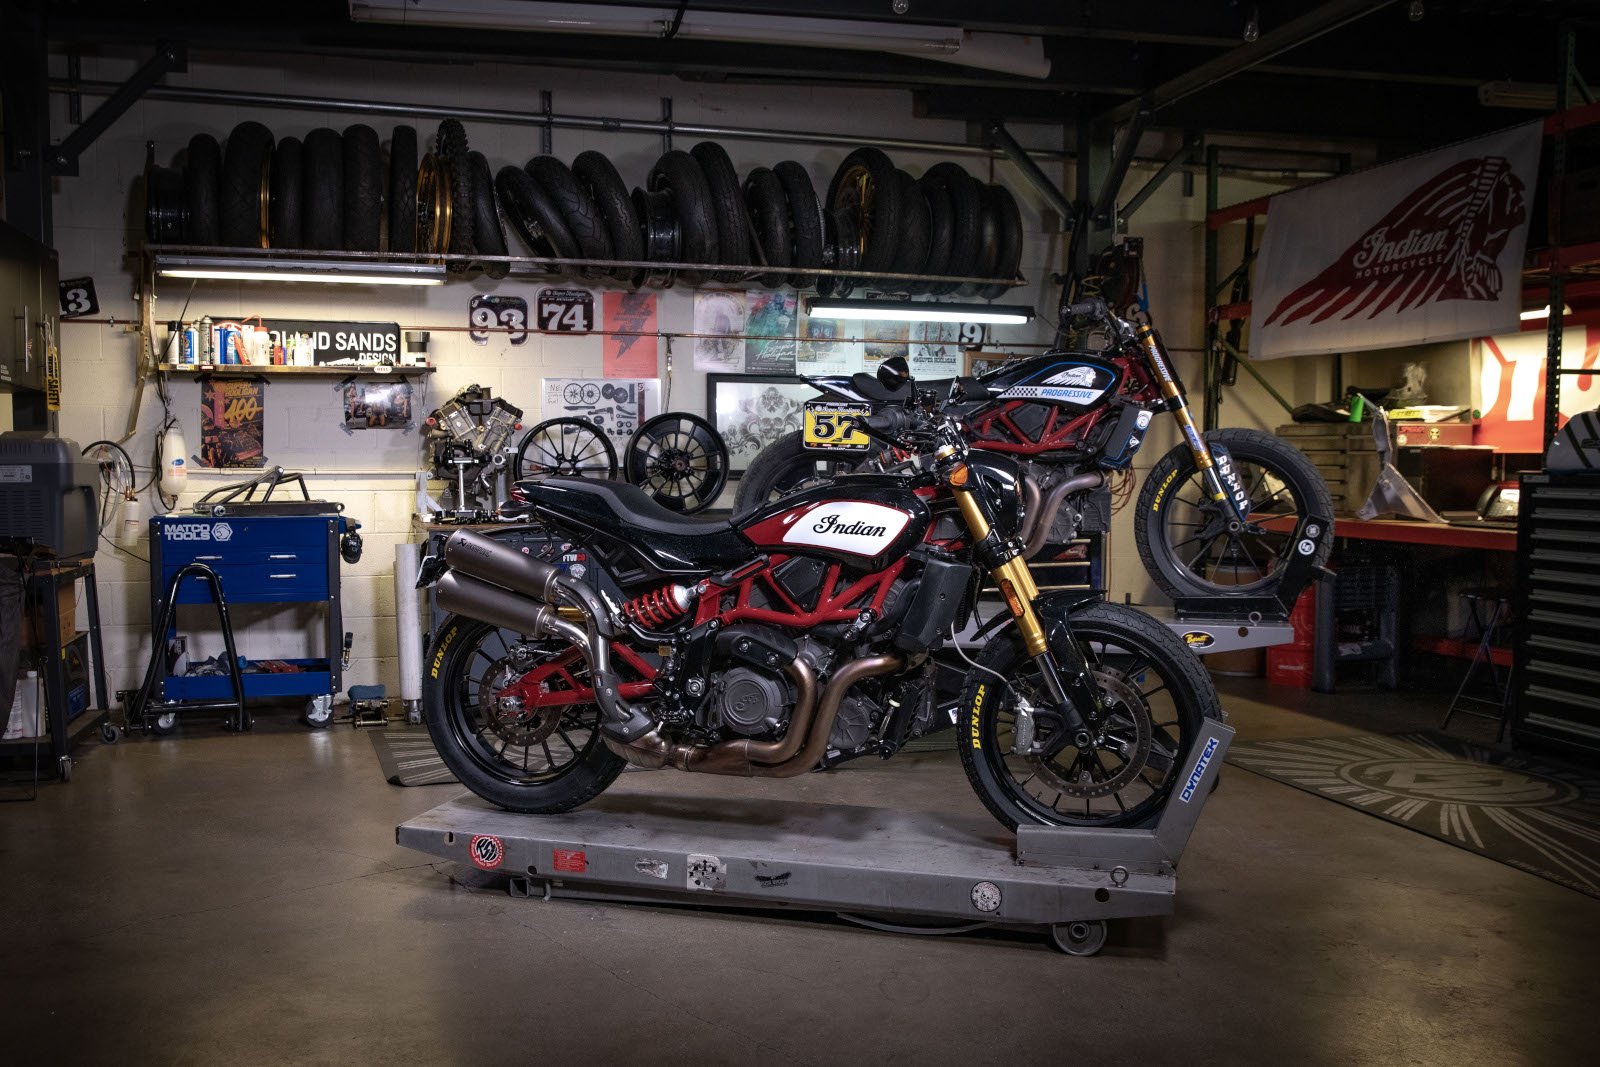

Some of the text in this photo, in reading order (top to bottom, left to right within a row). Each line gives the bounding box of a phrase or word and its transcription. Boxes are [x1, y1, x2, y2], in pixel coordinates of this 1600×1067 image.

[1353, 227, 1447, 268] Indian
[1355, 254, 1443, 279] MOTORCYCLE
[472, 307, 525, 339] 93
[542, 303, 588, 331] 74
[335, 332, 397, 352] SANDS
[1148, 344, 1173, 382] PROGRESSIVE
[48, 379, 60, 407] SAFETY
[1041, 388, 1094, 399] PROGRESSIVE
[224, 397, 264, 423] 400
[813, 414, 859, 440] 57
[1153, 469, 1178, 512] DUNLOP
[1215, 455, 1249, 510] DUNLOP
[164, 523, 211, 532] MATCO
[164, 532, 211, 541] TOOLS
[812, 513, 887, 537] Indian
[431, 626, 458, 679] DUNLOP
[972, 684, 986, 750] DUNLOP
[1182, 737, 1219, 801] DYNATEK
